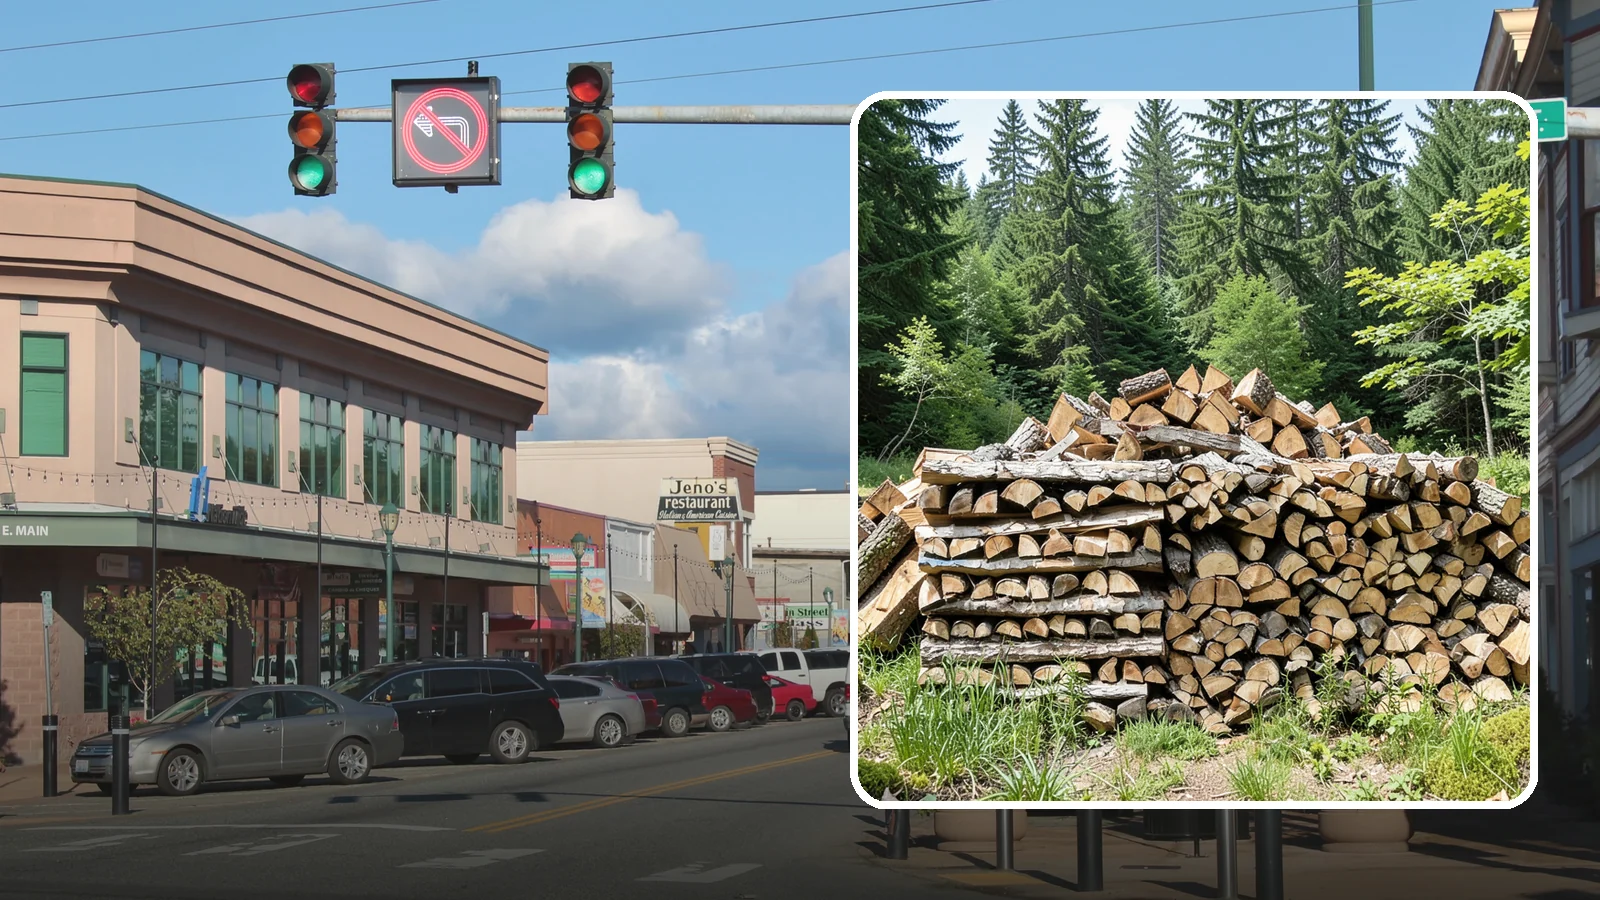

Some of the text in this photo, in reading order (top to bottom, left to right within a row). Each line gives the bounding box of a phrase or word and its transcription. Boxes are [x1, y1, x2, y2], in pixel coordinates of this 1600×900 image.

[669, 480, 728, 495] Jeno's
[665, 496, 731, 509] restaurant
[658, 509, 681, 520] Italian
[686, 510, 714, 519] American
[715, 509, 737, 519] Cuisine
[2, 525, 49, 536] E. MAIN
[785, 607, 795, 617] in
[797, 607, 828, 617] Street
[790, 619, 823, 627] lass
